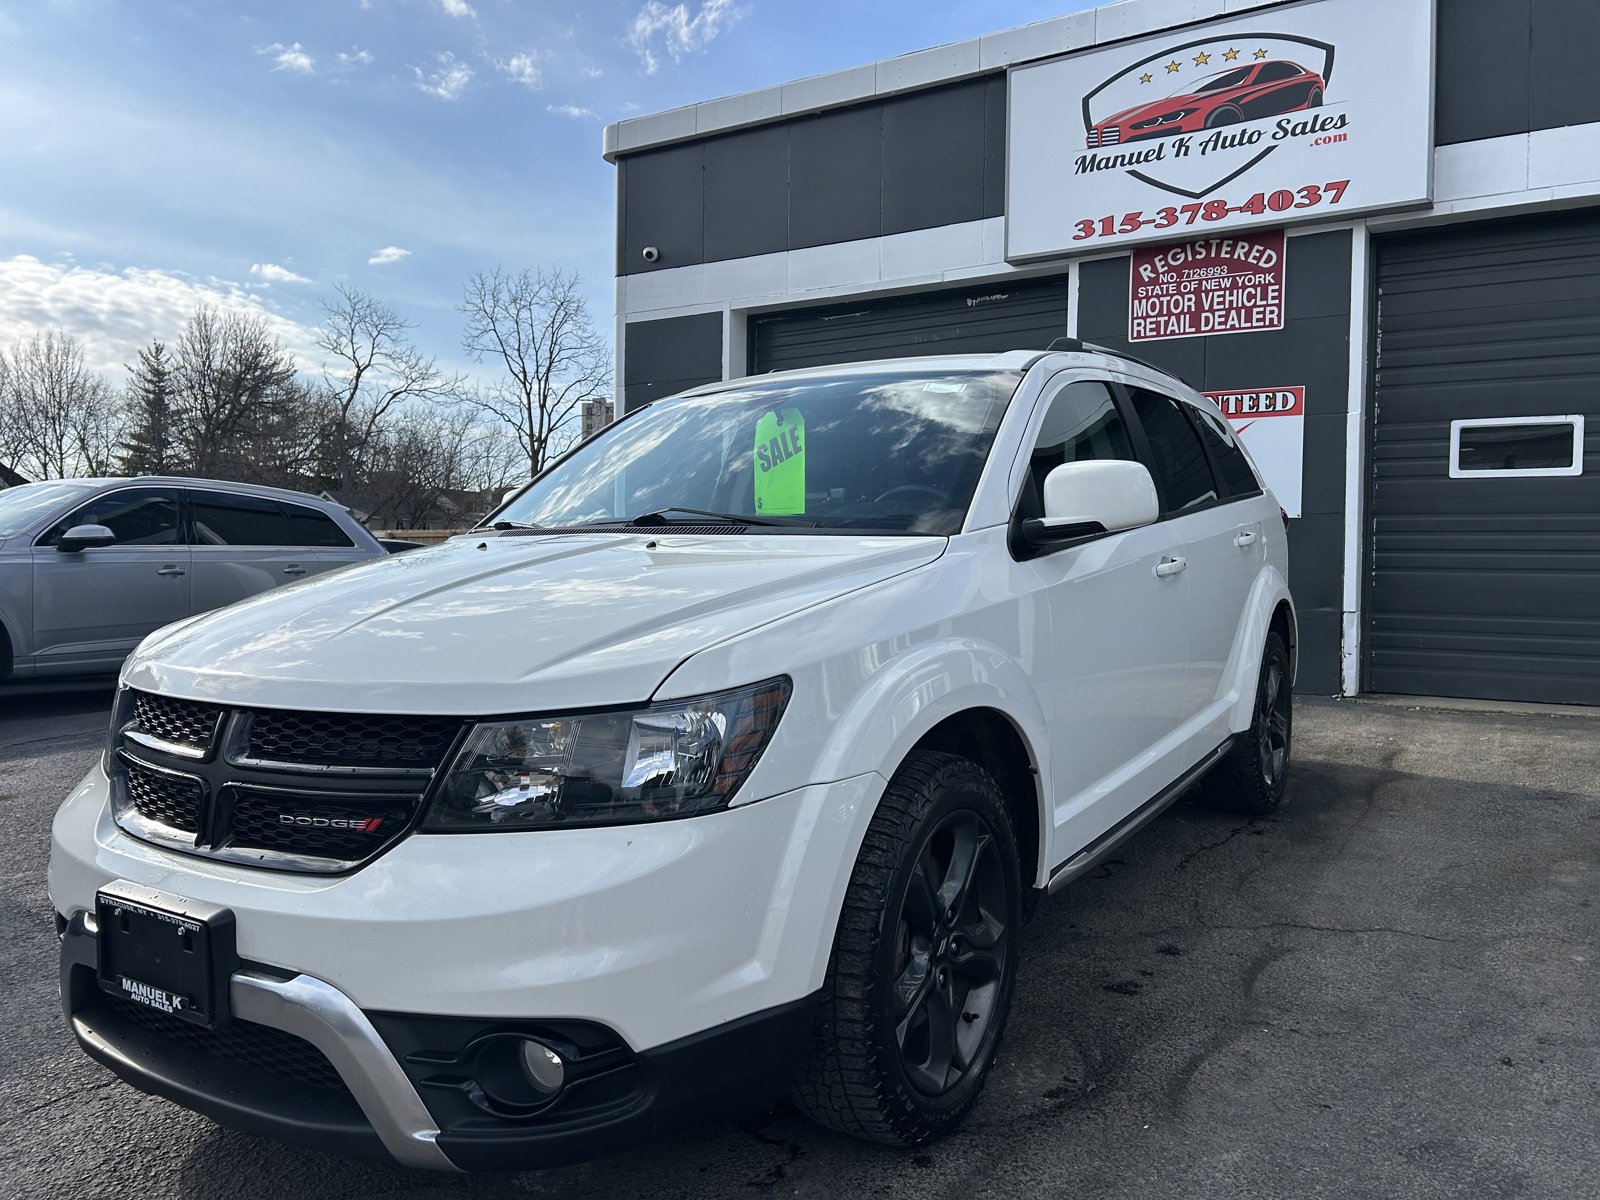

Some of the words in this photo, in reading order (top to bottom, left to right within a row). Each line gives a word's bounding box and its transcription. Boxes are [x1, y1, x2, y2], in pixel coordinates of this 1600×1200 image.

[1074, 143, 1165, 174] Manuel
[1171, 136, 1194, 158] K
[1199, 130, 1267, 156] Auto
[1271, 112, 1350, 140] Sales
[1309, 132, 1348, 148] .com
[1072, 179, 1351, 241] 315-378-4037
[1138, 239, 1277, 282] REGISTERED
[1159, 272, 1180, 284] NO.
[1182, 265, 1228, 280] 7126993
[1138, 283, 1177, 297] STATE
[1180, 280, 1199, 293] OF
[1202, 277, 1233, 291] NEW
[1236, 272, 1275, 287] YORK
[1133, 293, 1195, 318] MOTOR
[1201, 285, 1280, 310] VEHICLE
[1133, 314, 1196, 337] RETAIL
[1201, 306, 1279, 332] DEALER
[1206, 391, 1297, 414] NTEED
[757, 424, 803, 473] SALE
[279, 814, 367, 829] DODGE
[122, 978, 170, 1005] MANUEL
[172, 995, 182, 1010] K
[131, 992, 150, 1005] AUTO
[150, 999, 173, 1013] SALES
